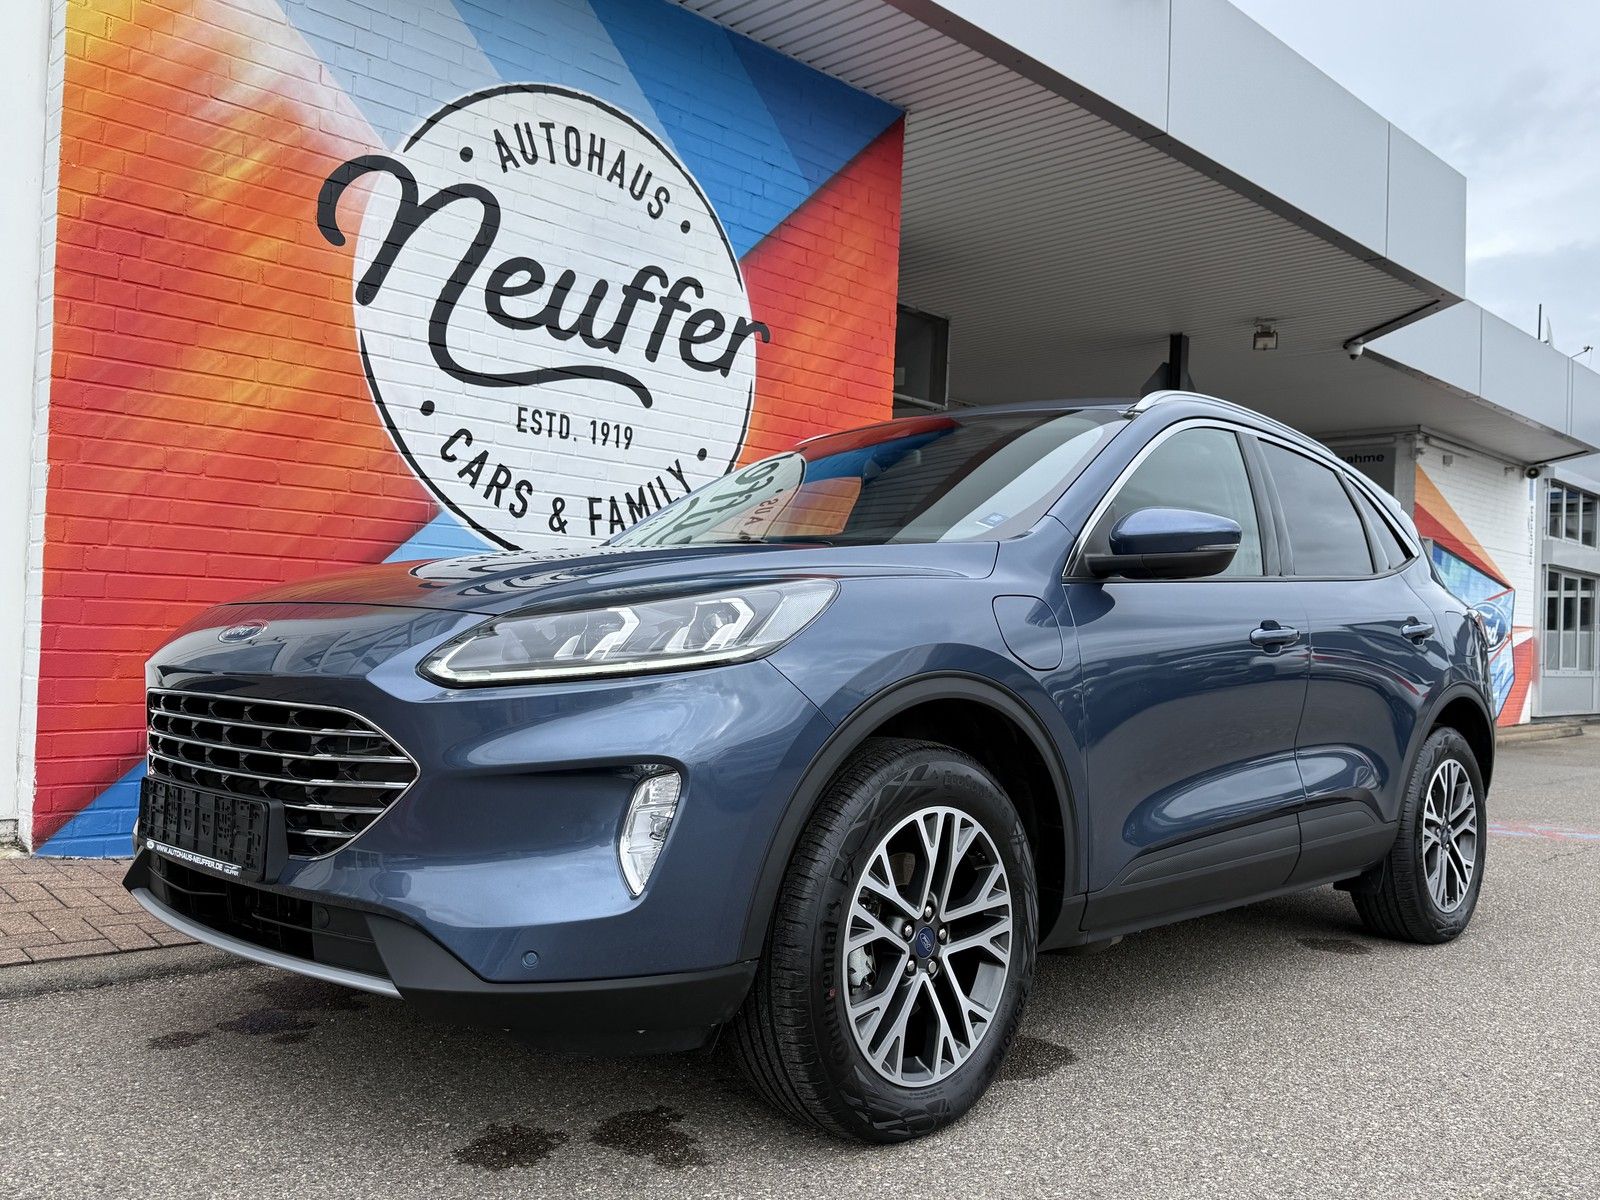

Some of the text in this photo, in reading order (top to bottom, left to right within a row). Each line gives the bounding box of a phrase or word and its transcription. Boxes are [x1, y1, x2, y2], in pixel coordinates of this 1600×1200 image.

[494, 121, 671, 219] AUTOHAUS
[317, 154, 770, 408] Neuffer
[516, 406, 634, 450] ESTD. 1919
[440, 428, 533, 518] CARS
[548, 496, 568, 534] &
[588, 459, 692, 536] FAMILY
